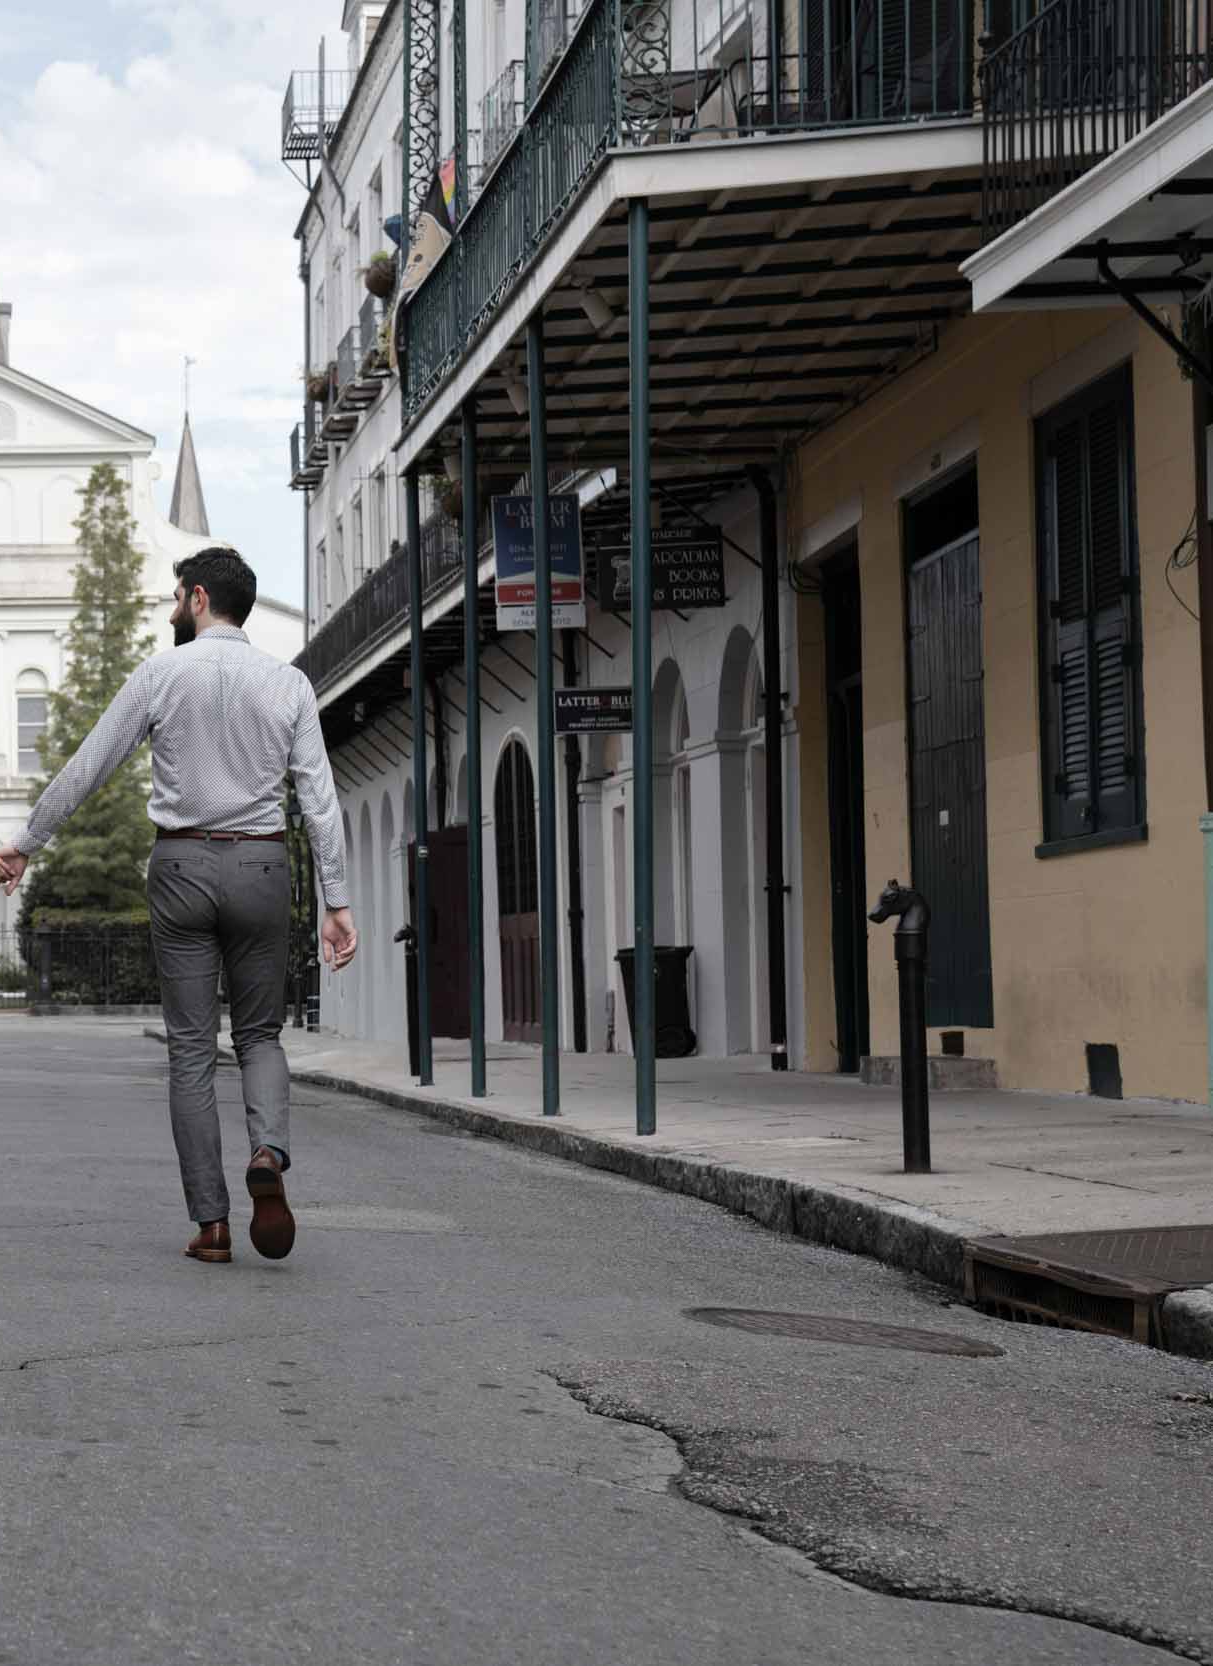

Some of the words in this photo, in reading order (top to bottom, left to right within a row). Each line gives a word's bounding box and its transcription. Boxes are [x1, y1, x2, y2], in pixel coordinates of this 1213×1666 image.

[652, 549, 720, 565] ARCADIAN
[668, 568, 721, 583] BOOKS
[673, 587, 721, 601] PRINTS
[557, 696, 601, 707] LATTER
